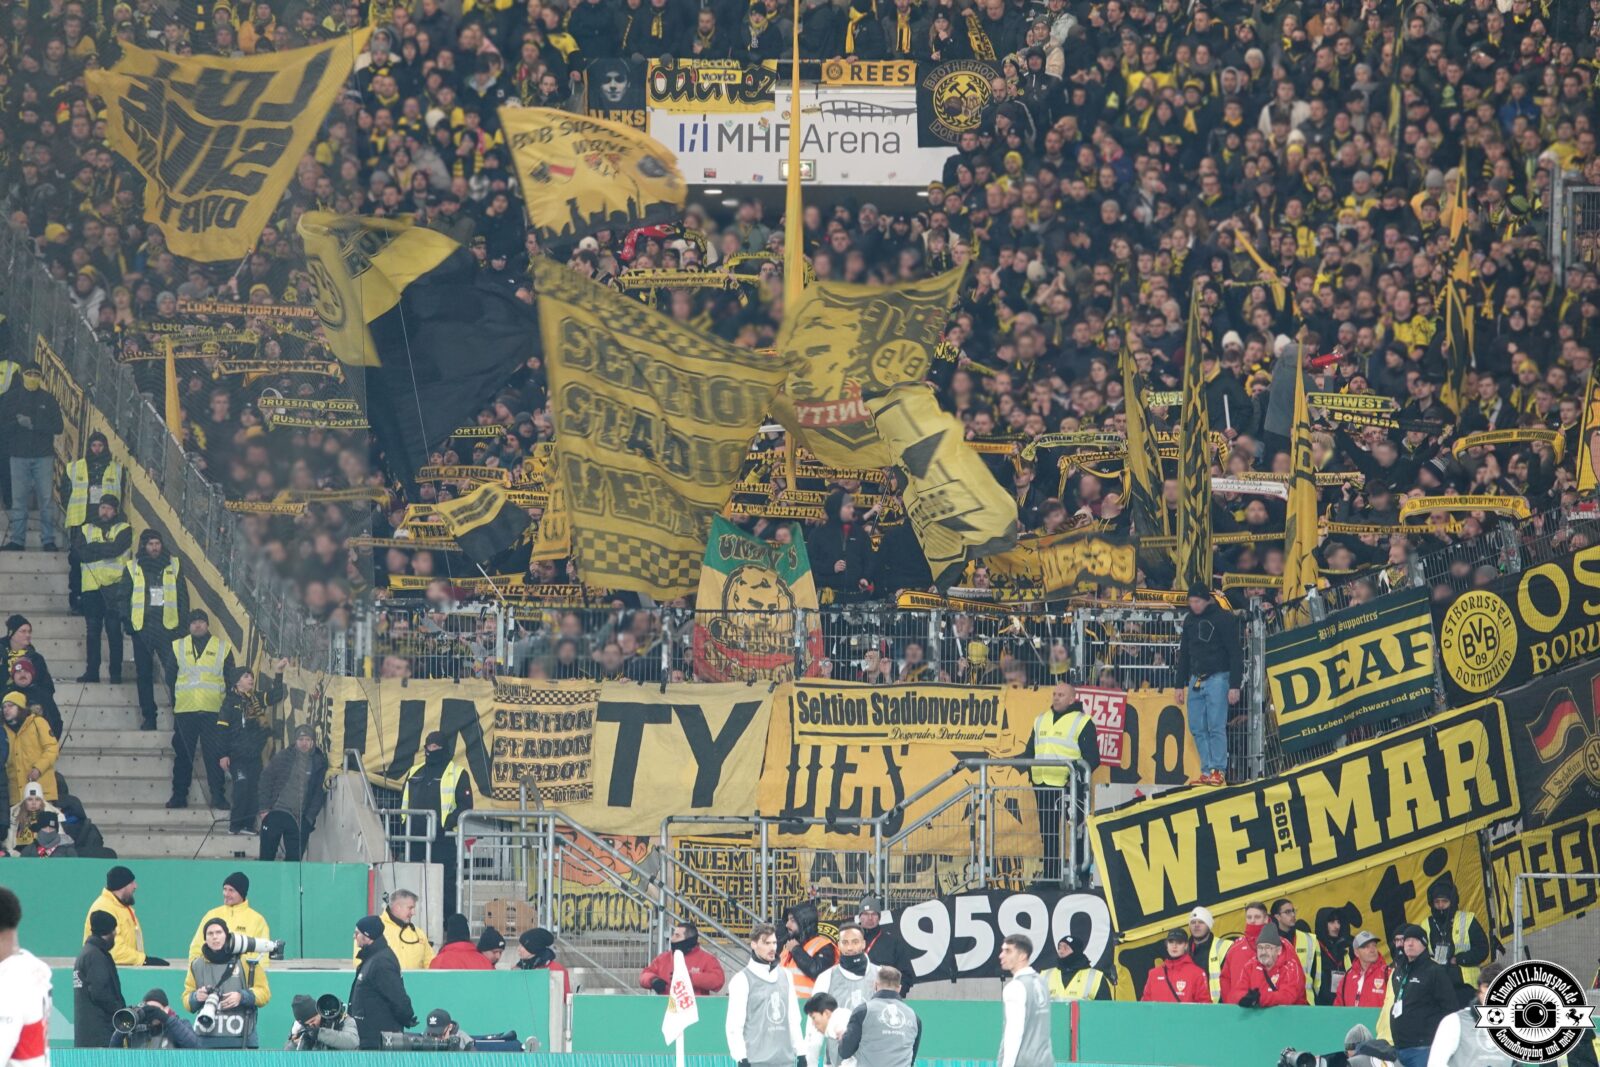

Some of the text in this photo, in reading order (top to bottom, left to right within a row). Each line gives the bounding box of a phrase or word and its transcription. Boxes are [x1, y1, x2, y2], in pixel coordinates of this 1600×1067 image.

[850, 64, 910, 82] REES
[925, 60, 997, 88] BROTHERHOO
[799, 124, 901, 153] Arena
[328, 401, 360, 411] DORT
[1333, 411, 1400, 429] BORUSSIA
[539, 584, 582, 597] UNIT
[1338, 611, 1378, 632] Supporters
[1462, 617, 1498, 659] BVB
[1273, 622, 1433, 716] DEAF
[1455, 649, 1512, 688] DORTMUND
[1475, 652, 1488, 666] 09
[494, 708, 594, 733] SEKTION
[796, 690, 1000, 727] Sektion Stadionverbot
[1301, 728, 1317, 737] Ein
[1318, 718, 1344, 731] Leben
[1391, 693, 1408, 705] und
[1409, 686, 1432, 701] gelb
[493, 733, 593, 759] STADION
[1111, 717, 1500, 917] WEIMAR
[1273, 801, 1293, 855] 1909
